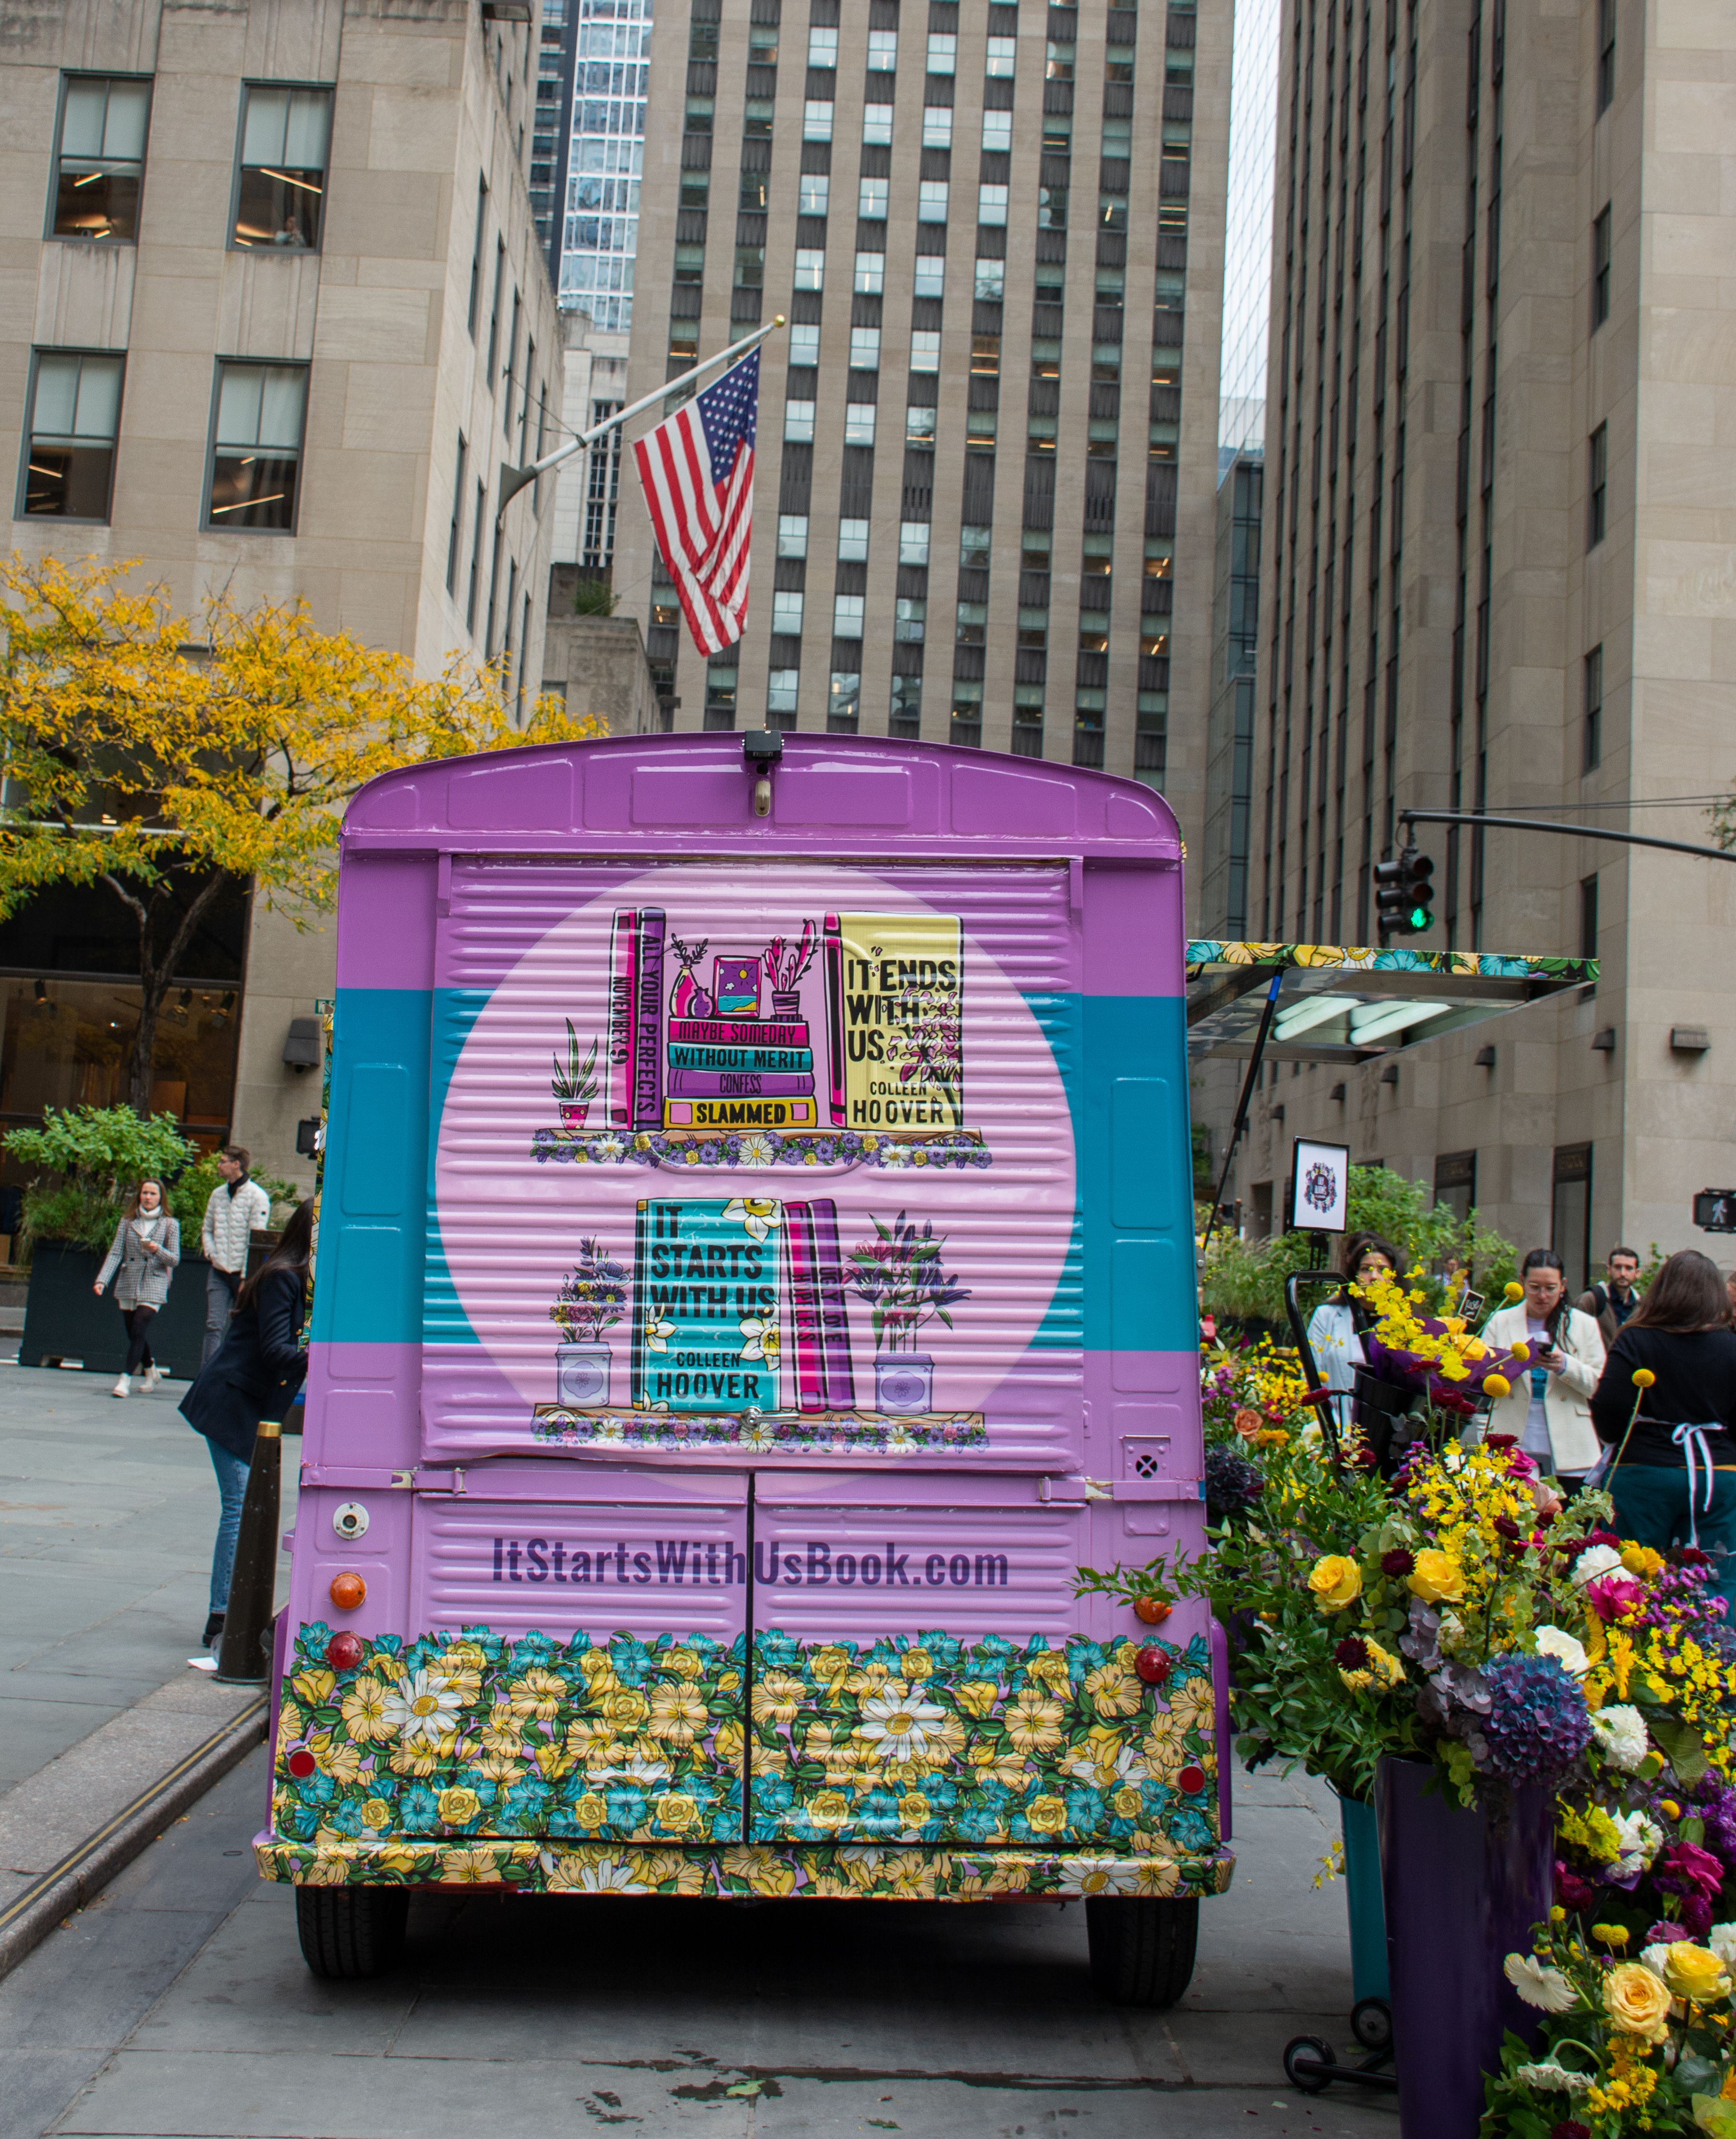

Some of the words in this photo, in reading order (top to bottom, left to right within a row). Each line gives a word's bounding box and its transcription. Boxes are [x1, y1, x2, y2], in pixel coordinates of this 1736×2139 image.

[641, 934, 661, 965] ALL
[640, 969, 659, 1015] YOUR
[849, 960, 872, 991] IT
[880, 960, 956, 992] ENDS
[612, 976, 632, 1044] NOVEMBER
[846, 994, 920, 1025] WITH
[679, 1021, 726, 1040] MAYBE
[730, 1023, 795, 1044] SOMEDAY
[848, 1029, 885, 1062] US
[609, 1048, 630, 1065] 9
[637, 1023, 657, 1113] PERFECTS
[674, 1047, 748, 1067] WITHOUT
[753, 1050, 805, 1069] MERIT
[720, 1074, 762, 1094] CONFESS
[870, 1081, 927, 1096] COLLEEN
[696, 1103, 786, 1124] SLAMMED
[853, 1099, 944, 1124] HOOVER
[656, 1205, 683, 1239] IT
[651, 1243, 763, 1280] STARTS
[819, 1267, 838, 1301] UGLY
[650, 1285, 728, 1319] WITH
[736, 1285, 775, 1319] US
[792, 1273, 816, 1341] HOPELESS
[822, 1306, 842, 1344] LOVE
[676, 1351, 740, 1368] COLLEEN
[657, 1372, 759, 1399] HOOVER
[492, 1538, 1008, 1586] ItStartsWithUsBook.com
